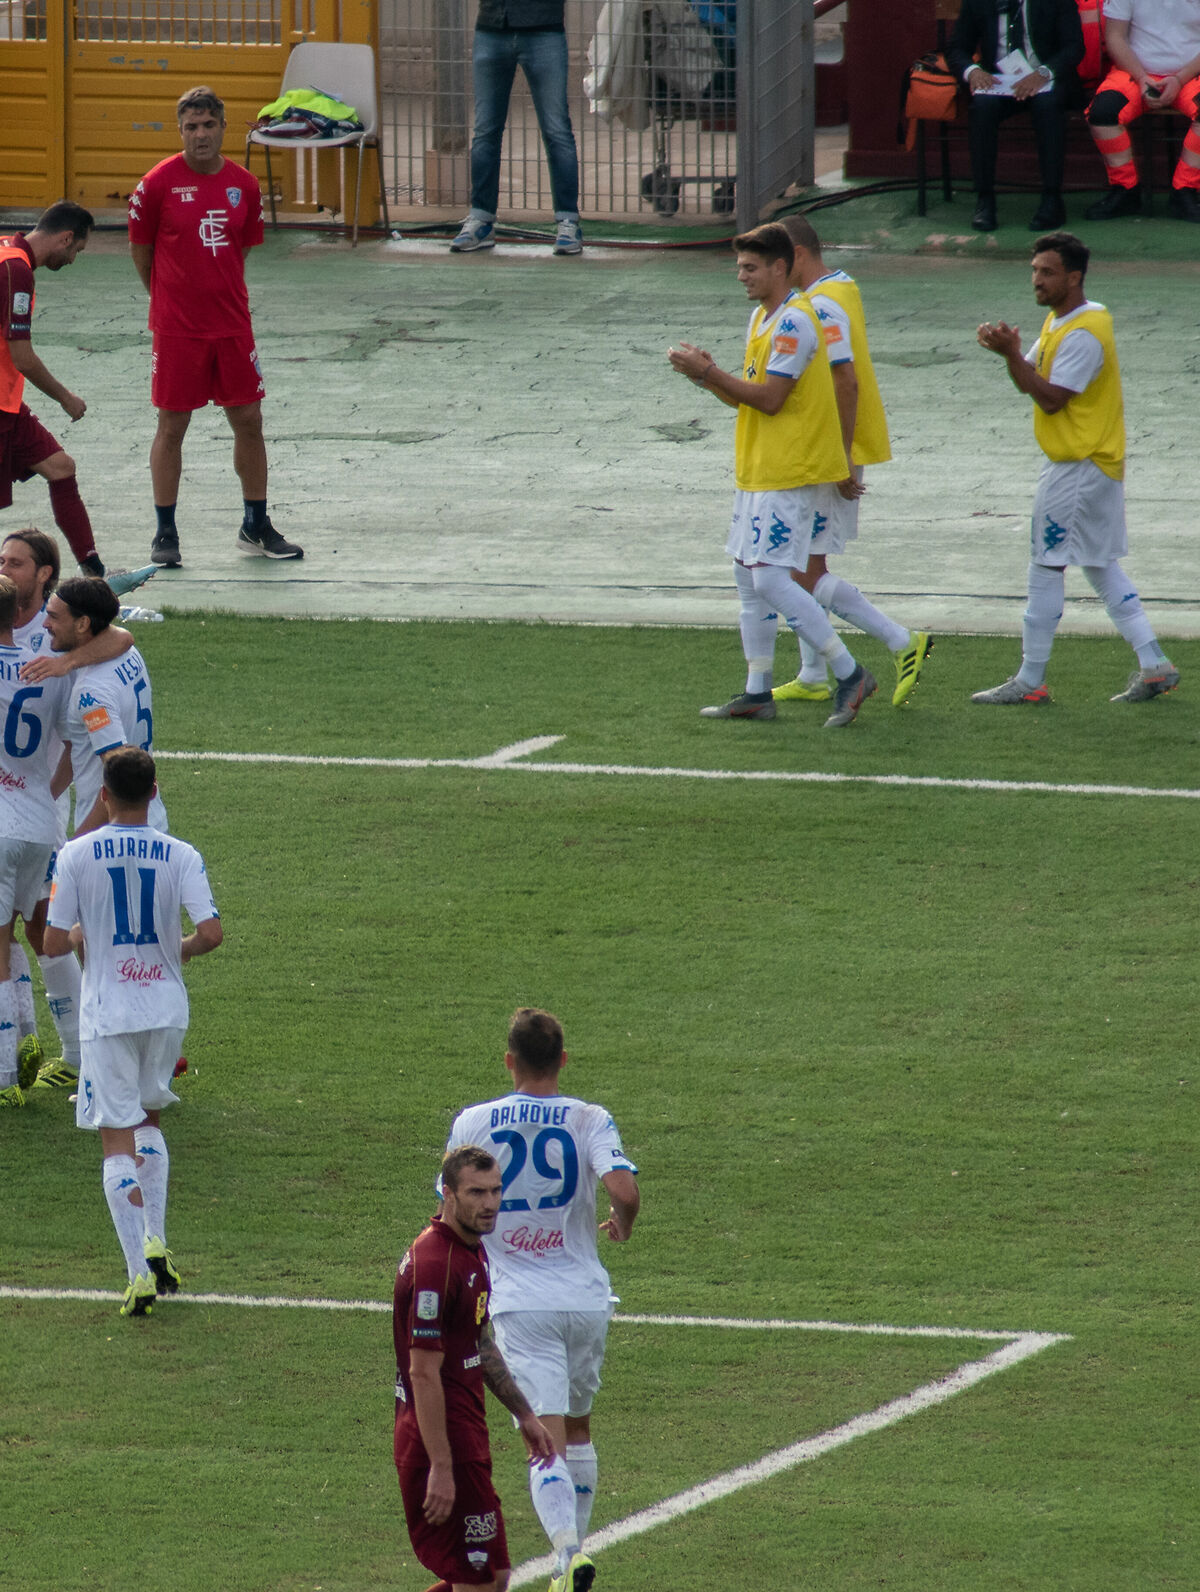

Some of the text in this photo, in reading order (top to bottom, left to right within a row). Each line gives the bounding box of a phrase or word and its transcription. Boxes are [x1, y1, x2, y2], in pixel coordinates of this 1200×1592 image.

[93, 837, 172, 862] BAJRAMI
[106, 866, 160, 946] 11
[490, 1127, 580, 1213] 29
